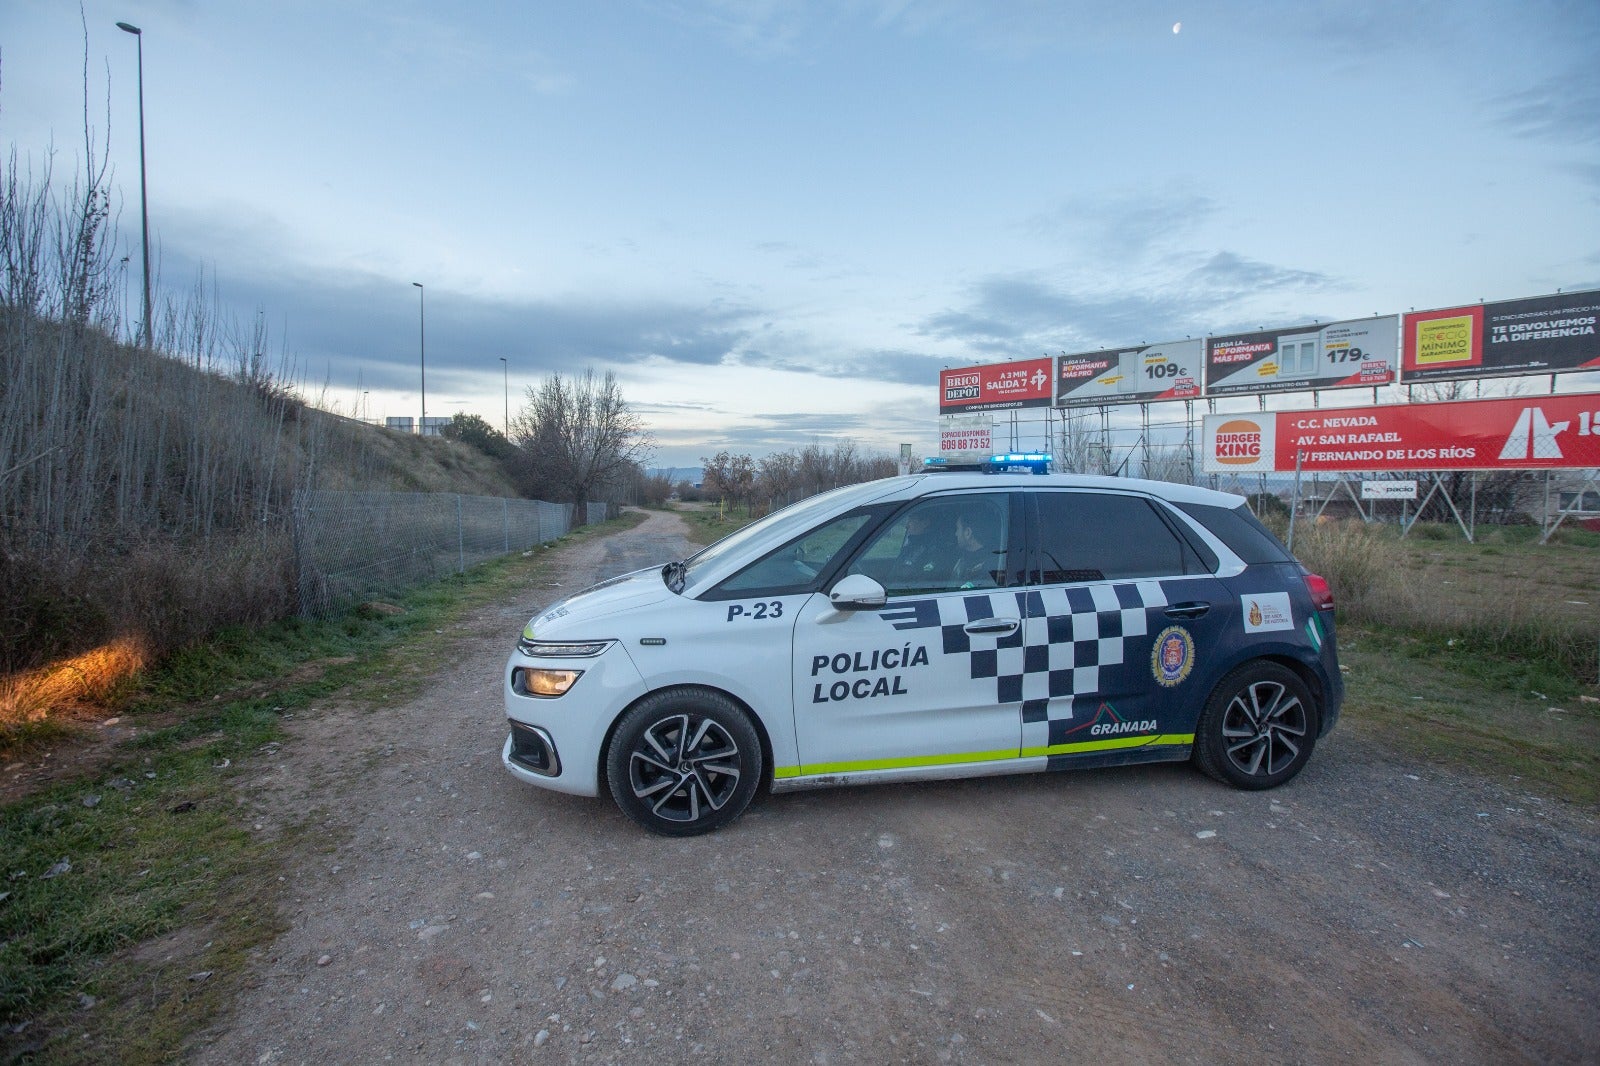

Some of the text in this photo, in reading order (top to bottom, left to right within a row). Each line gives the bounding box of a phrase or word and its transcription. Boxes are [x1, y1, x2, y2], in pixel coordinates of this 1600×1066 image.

[1492, 316, 1596, 334] TE DEVOLVEMOS
[1492, 326, 1595, 343] LA DIFERENCIA
[947, 376, 978, 387] BRICO
[986, 380, 1019, 390] SALIDA
[1298, 416, 1378, 429] C.C. NEVADA
[942, 440, 956, 450] 609
[969, 438, 979, 449] 73
[980, 438, 990, 449] 52
[1216, 433, 1260, 443] BURGER
[1297, 432, 1402, 445] AV. SAN RAFAEL
[1216, 443, 1260, 456] KING
[1311, 450, 1383, 462] FERNANDO
[1386, 450, 1405, 459] DE
[1407, 449, 1436, 459] LOS
[1439, 445, 1476, 458] RÍOS
[727, 601, 783, 622] P-23
[811, 642, 929, 676] POLICÍA
[813, 676, 908, 704] LOCAL
[1090, 720, 1157, 735] GRANADA
